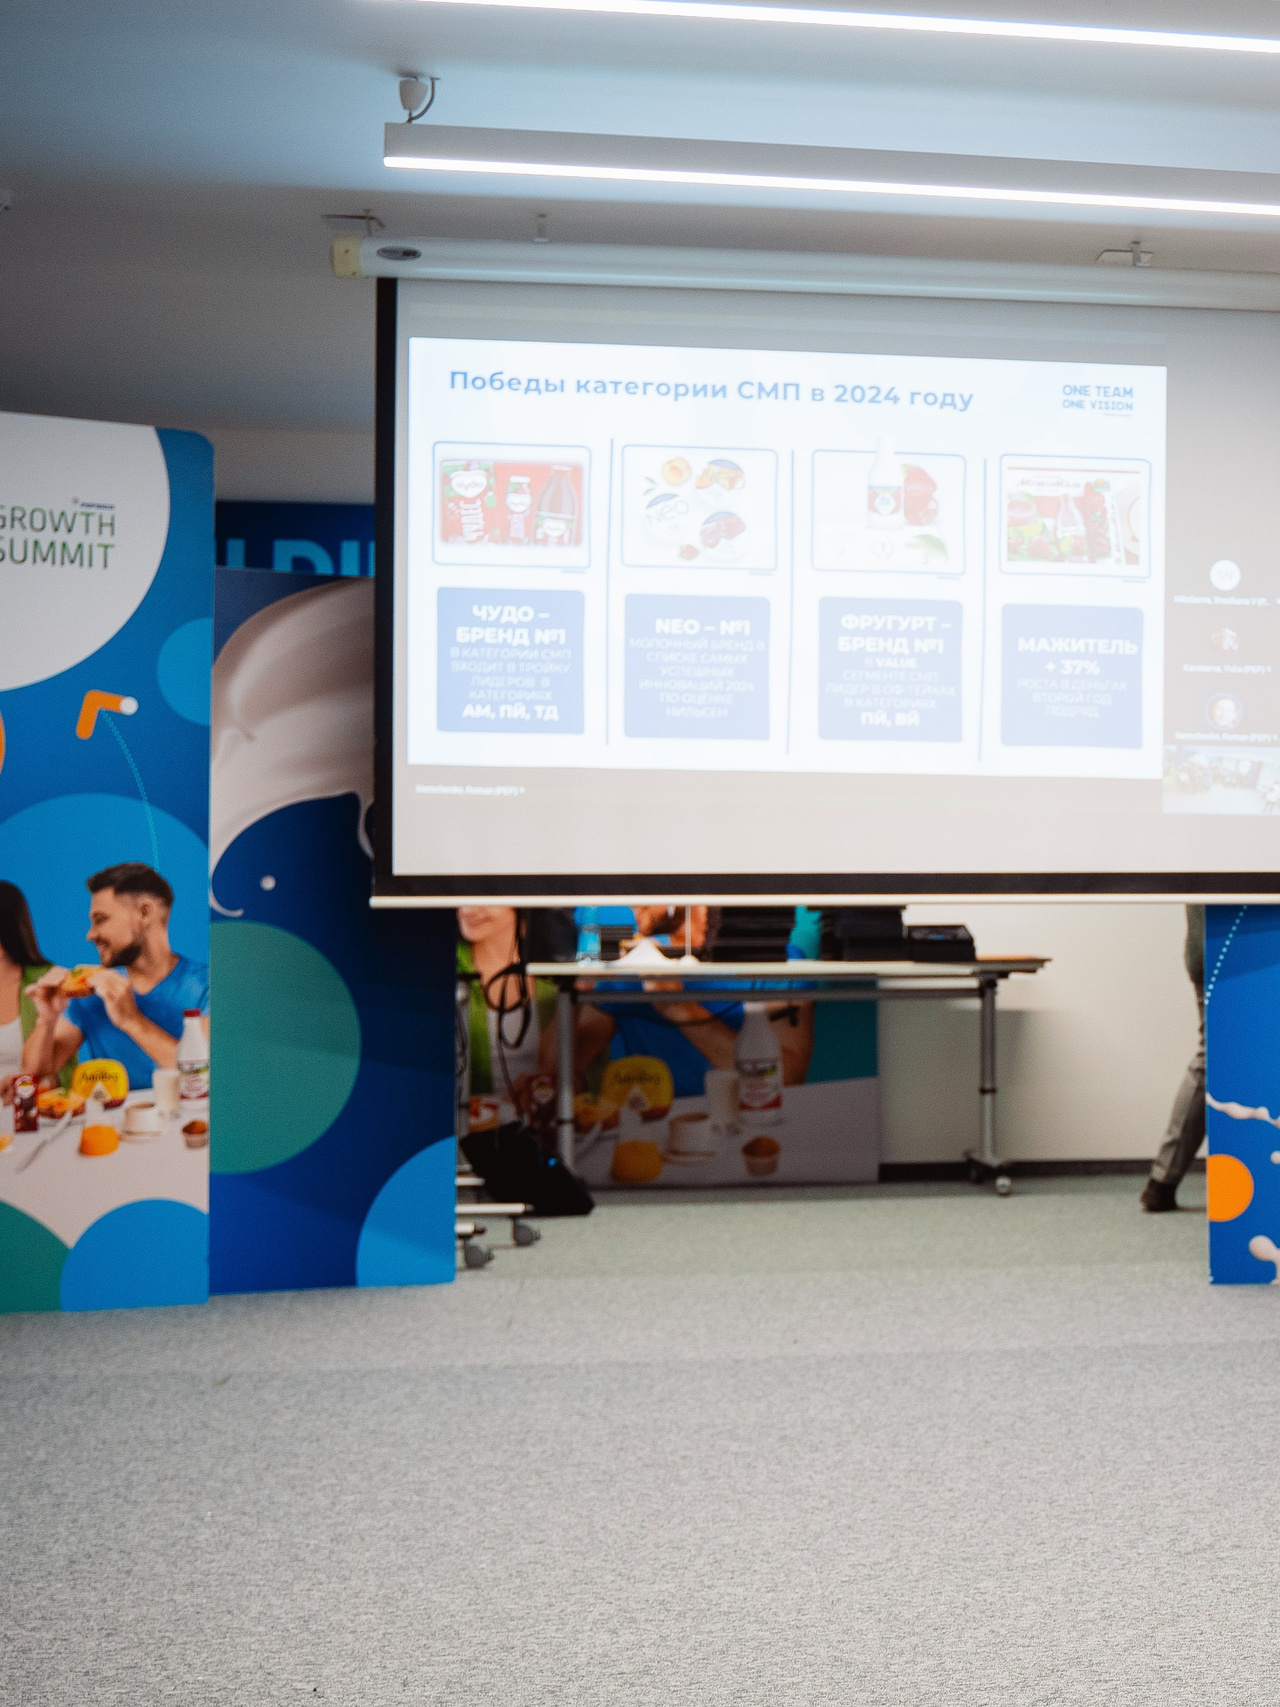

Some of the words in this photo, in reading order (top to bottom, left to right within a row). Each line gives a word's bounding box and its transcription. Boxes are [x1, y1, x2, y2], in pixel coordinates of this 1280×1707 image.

[450, 371, 565, 395] Победы
[576, 377, 728, 402] категории
[737, 380, 801, 401] СМП
[811, 387, 825, 402] в
[834, 384, 901, 405] 2024
[910, 391, 974, 412] году
[1062, 384, 1091, 396] ONE
[1095, 386, 1133, 398] TEAM
[1062, 399, 1085, 409] ONE
[1090, 400, 1133, 411] VISION
[472, 604, 534, 624] ЧУДО
[841, 613, 937, 631] ФРУГУРТ
[655, 618, 700, 635] NEO
[720, 620, 751, 636] №1
[456, 626, 530, 647] БРЕНД
[535, 629, 566, 645] №1
[838, 636, 909, 655] БРЕНД
[914, 638, 944, 654] №1
[1018, 636, 1139, 655] МАЖИТЕЛЬ
[875, 657, 918, 668] VALUE
[1060, 659, 1101, 675] 37%
